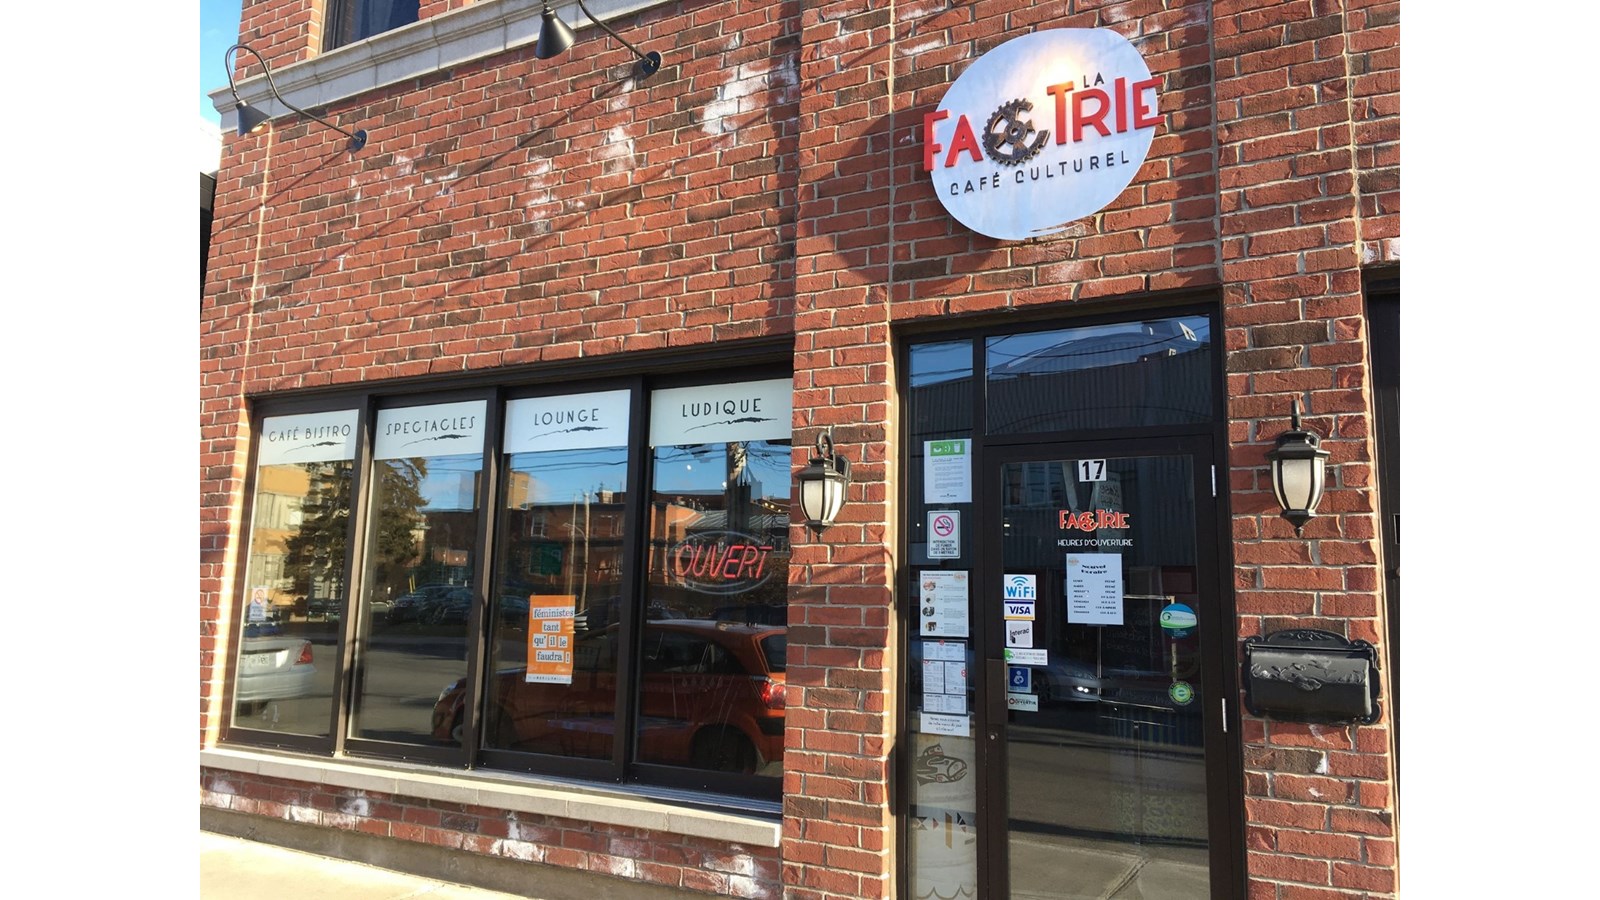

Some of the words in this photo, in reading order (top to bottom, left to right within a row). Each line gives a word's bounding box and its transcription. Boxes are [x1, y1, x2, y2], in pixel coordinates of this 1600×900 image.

[1083, 72, 1104, 88] LA
[950, 172, 1000, 196] CAFÉ
[1015, 150, 1129, 184] CULTUREL
[682, 398, 762, 418] LUDIQUE
[534, 408, 599, 426] LOUNGE
[268, 427, 298, 442] CAFÉ
[305, 424, 351, 439] BISTRO
[386, 416, 476, 436] SPECTACLES
[1082, 460, 1105, 481] 17
[1057, 538, 1083, 547] HEURES
[1084, 538, 1133, 547] D'OUVERTURE
[678, 544, 773, 579] OUVERT
[1006, 586, 1034, 598] WiFi
[533, 608, 574, 619] féministes
[1008, 605, 1031, 615] VISA
[543, 623, 560, 631] tant
[559, 637, 567, 647] le
[537, 651, 562, 661] faudra
